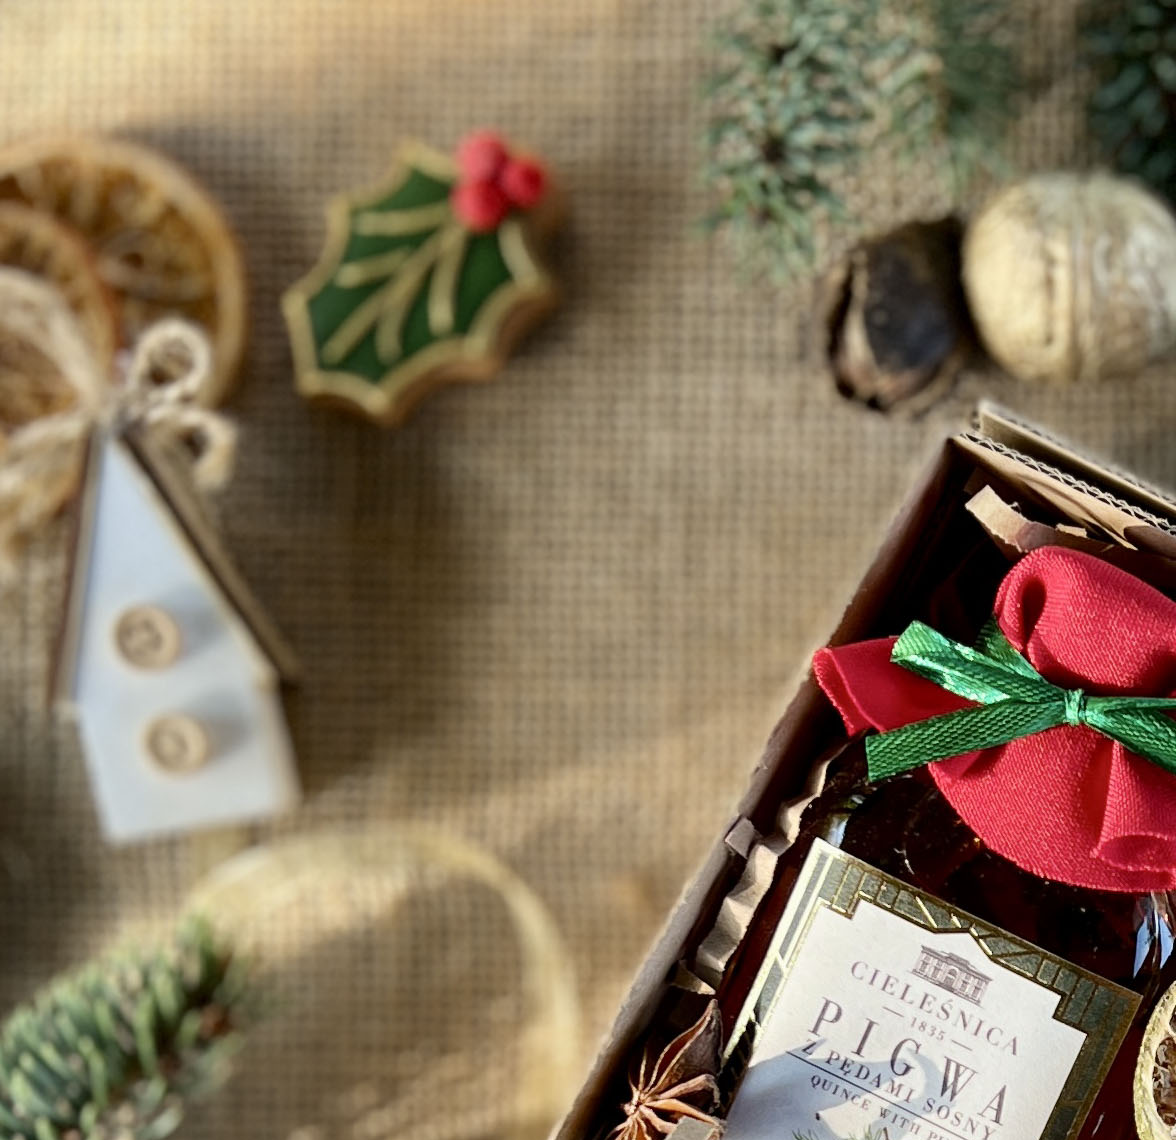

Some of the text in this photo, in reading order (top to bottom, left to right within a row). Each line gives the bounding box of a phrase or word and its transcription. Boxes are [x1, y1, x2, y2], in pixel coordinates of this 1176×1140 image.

[850, 960, 1019, 1056] CIELEŚNICA
[910, 1016, 947, 1042] 1835
[802, 1038, 821, 1056] Z
[825, 1051, 914, 1103] PĘDAMI
[808, 997, 1008, 1126] PIGWA
[810, 1073, 870, 1111] QUINCE
[879, 1105, 920, 1135] WITH
